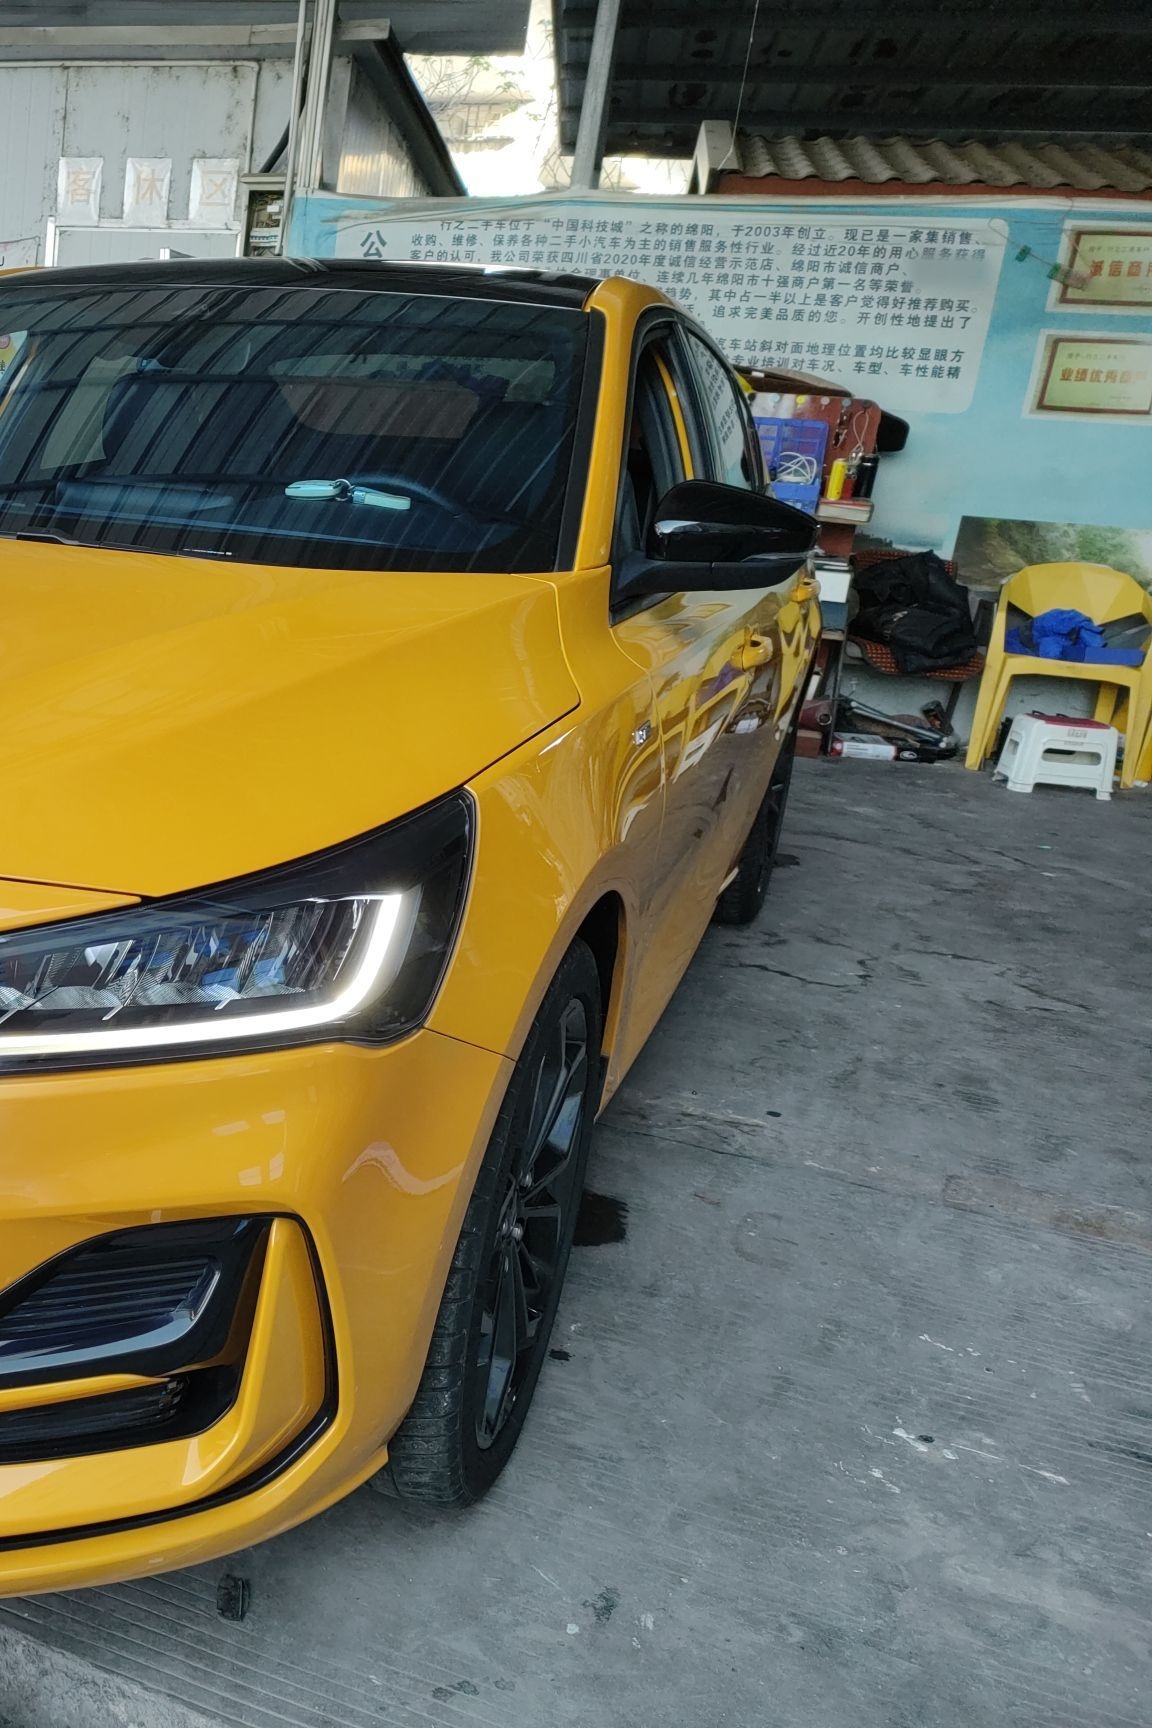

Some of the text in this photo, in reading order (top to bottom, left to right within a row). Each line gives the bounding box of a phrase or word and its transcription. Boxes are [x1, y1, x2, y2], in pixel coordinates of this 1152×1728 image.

[360, 230, 387, 258] 公
[725, 354, 961, 380] 专业培训对车况、车型、车性能精
